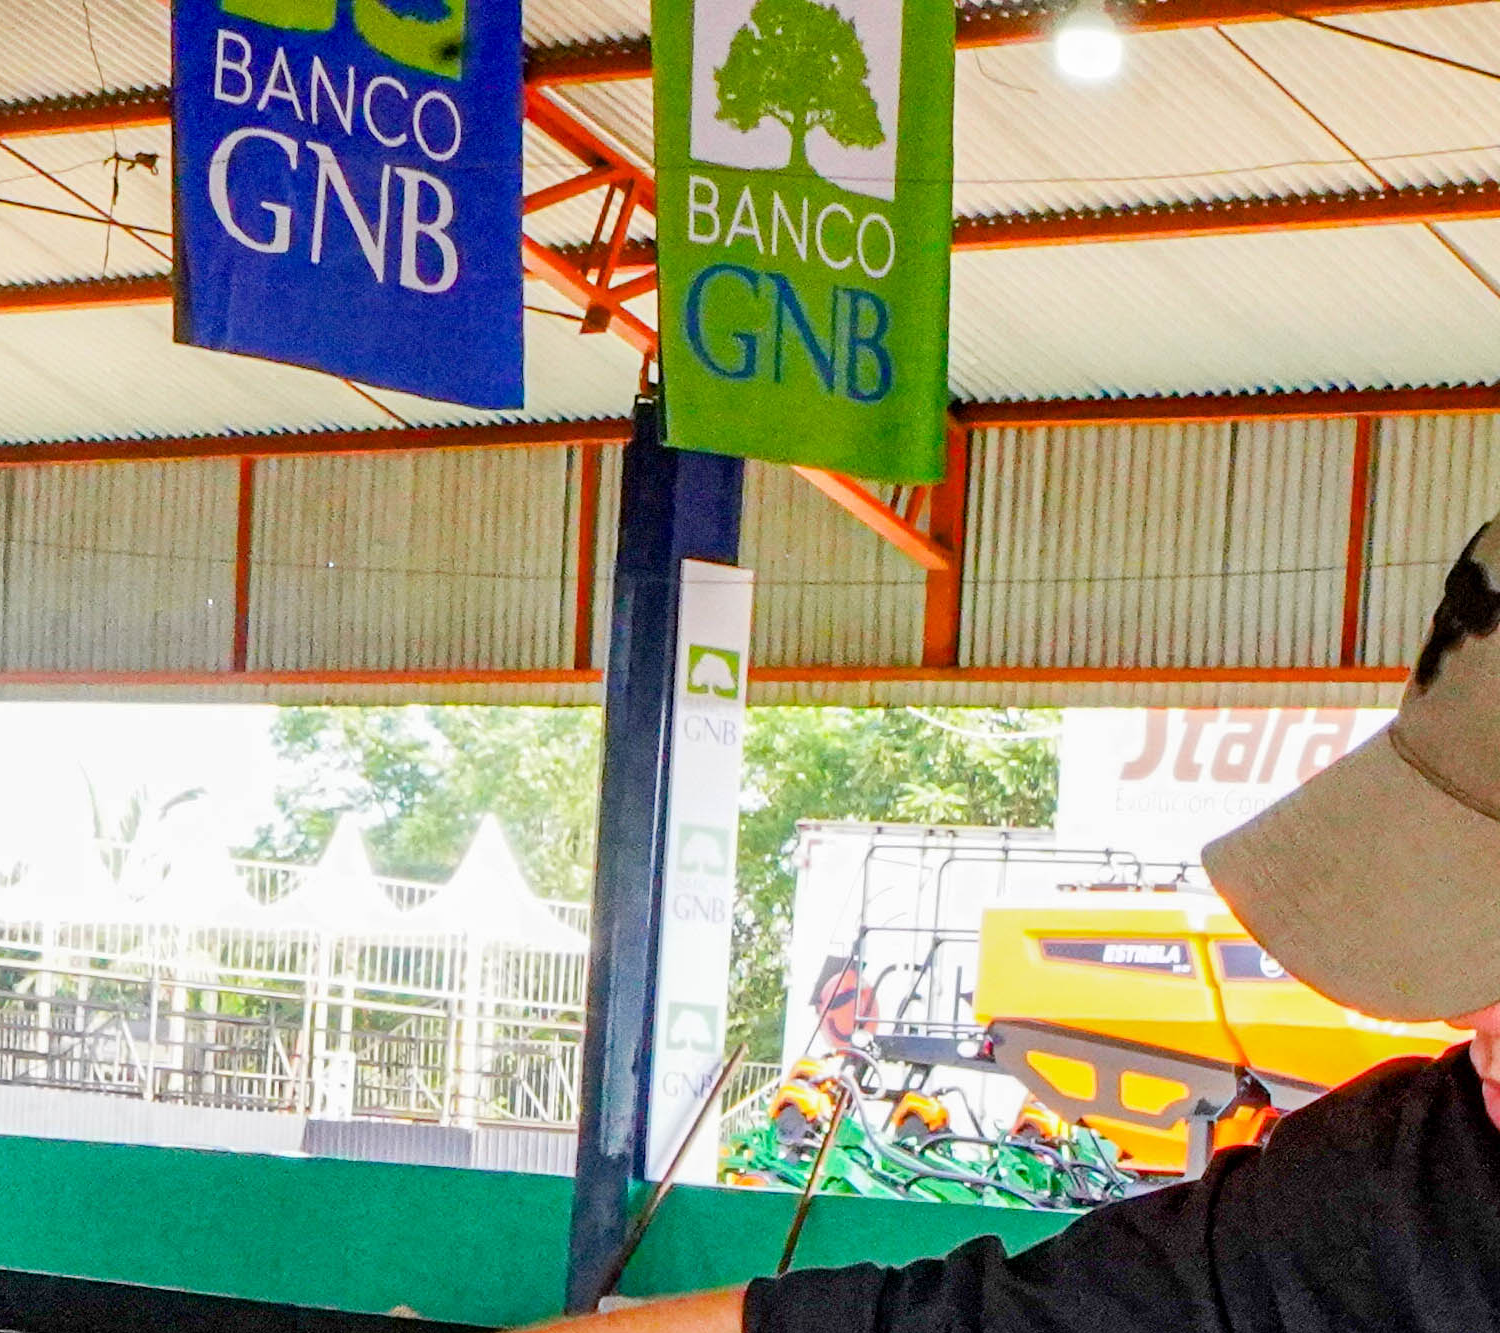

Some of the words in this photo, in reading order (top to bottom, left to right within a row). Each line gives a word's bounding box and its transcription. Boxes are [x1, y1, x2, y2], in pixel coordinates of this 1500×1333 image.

[213, 28, 463, 163] BANCO
[208, 127, 459, 295] GNB
[687, 174, 896, 281] BANCO
[684, 262, 895, 403] GNB
[683, 714, 738, 746] GNB
[673, 893, 725, 923] GNB
